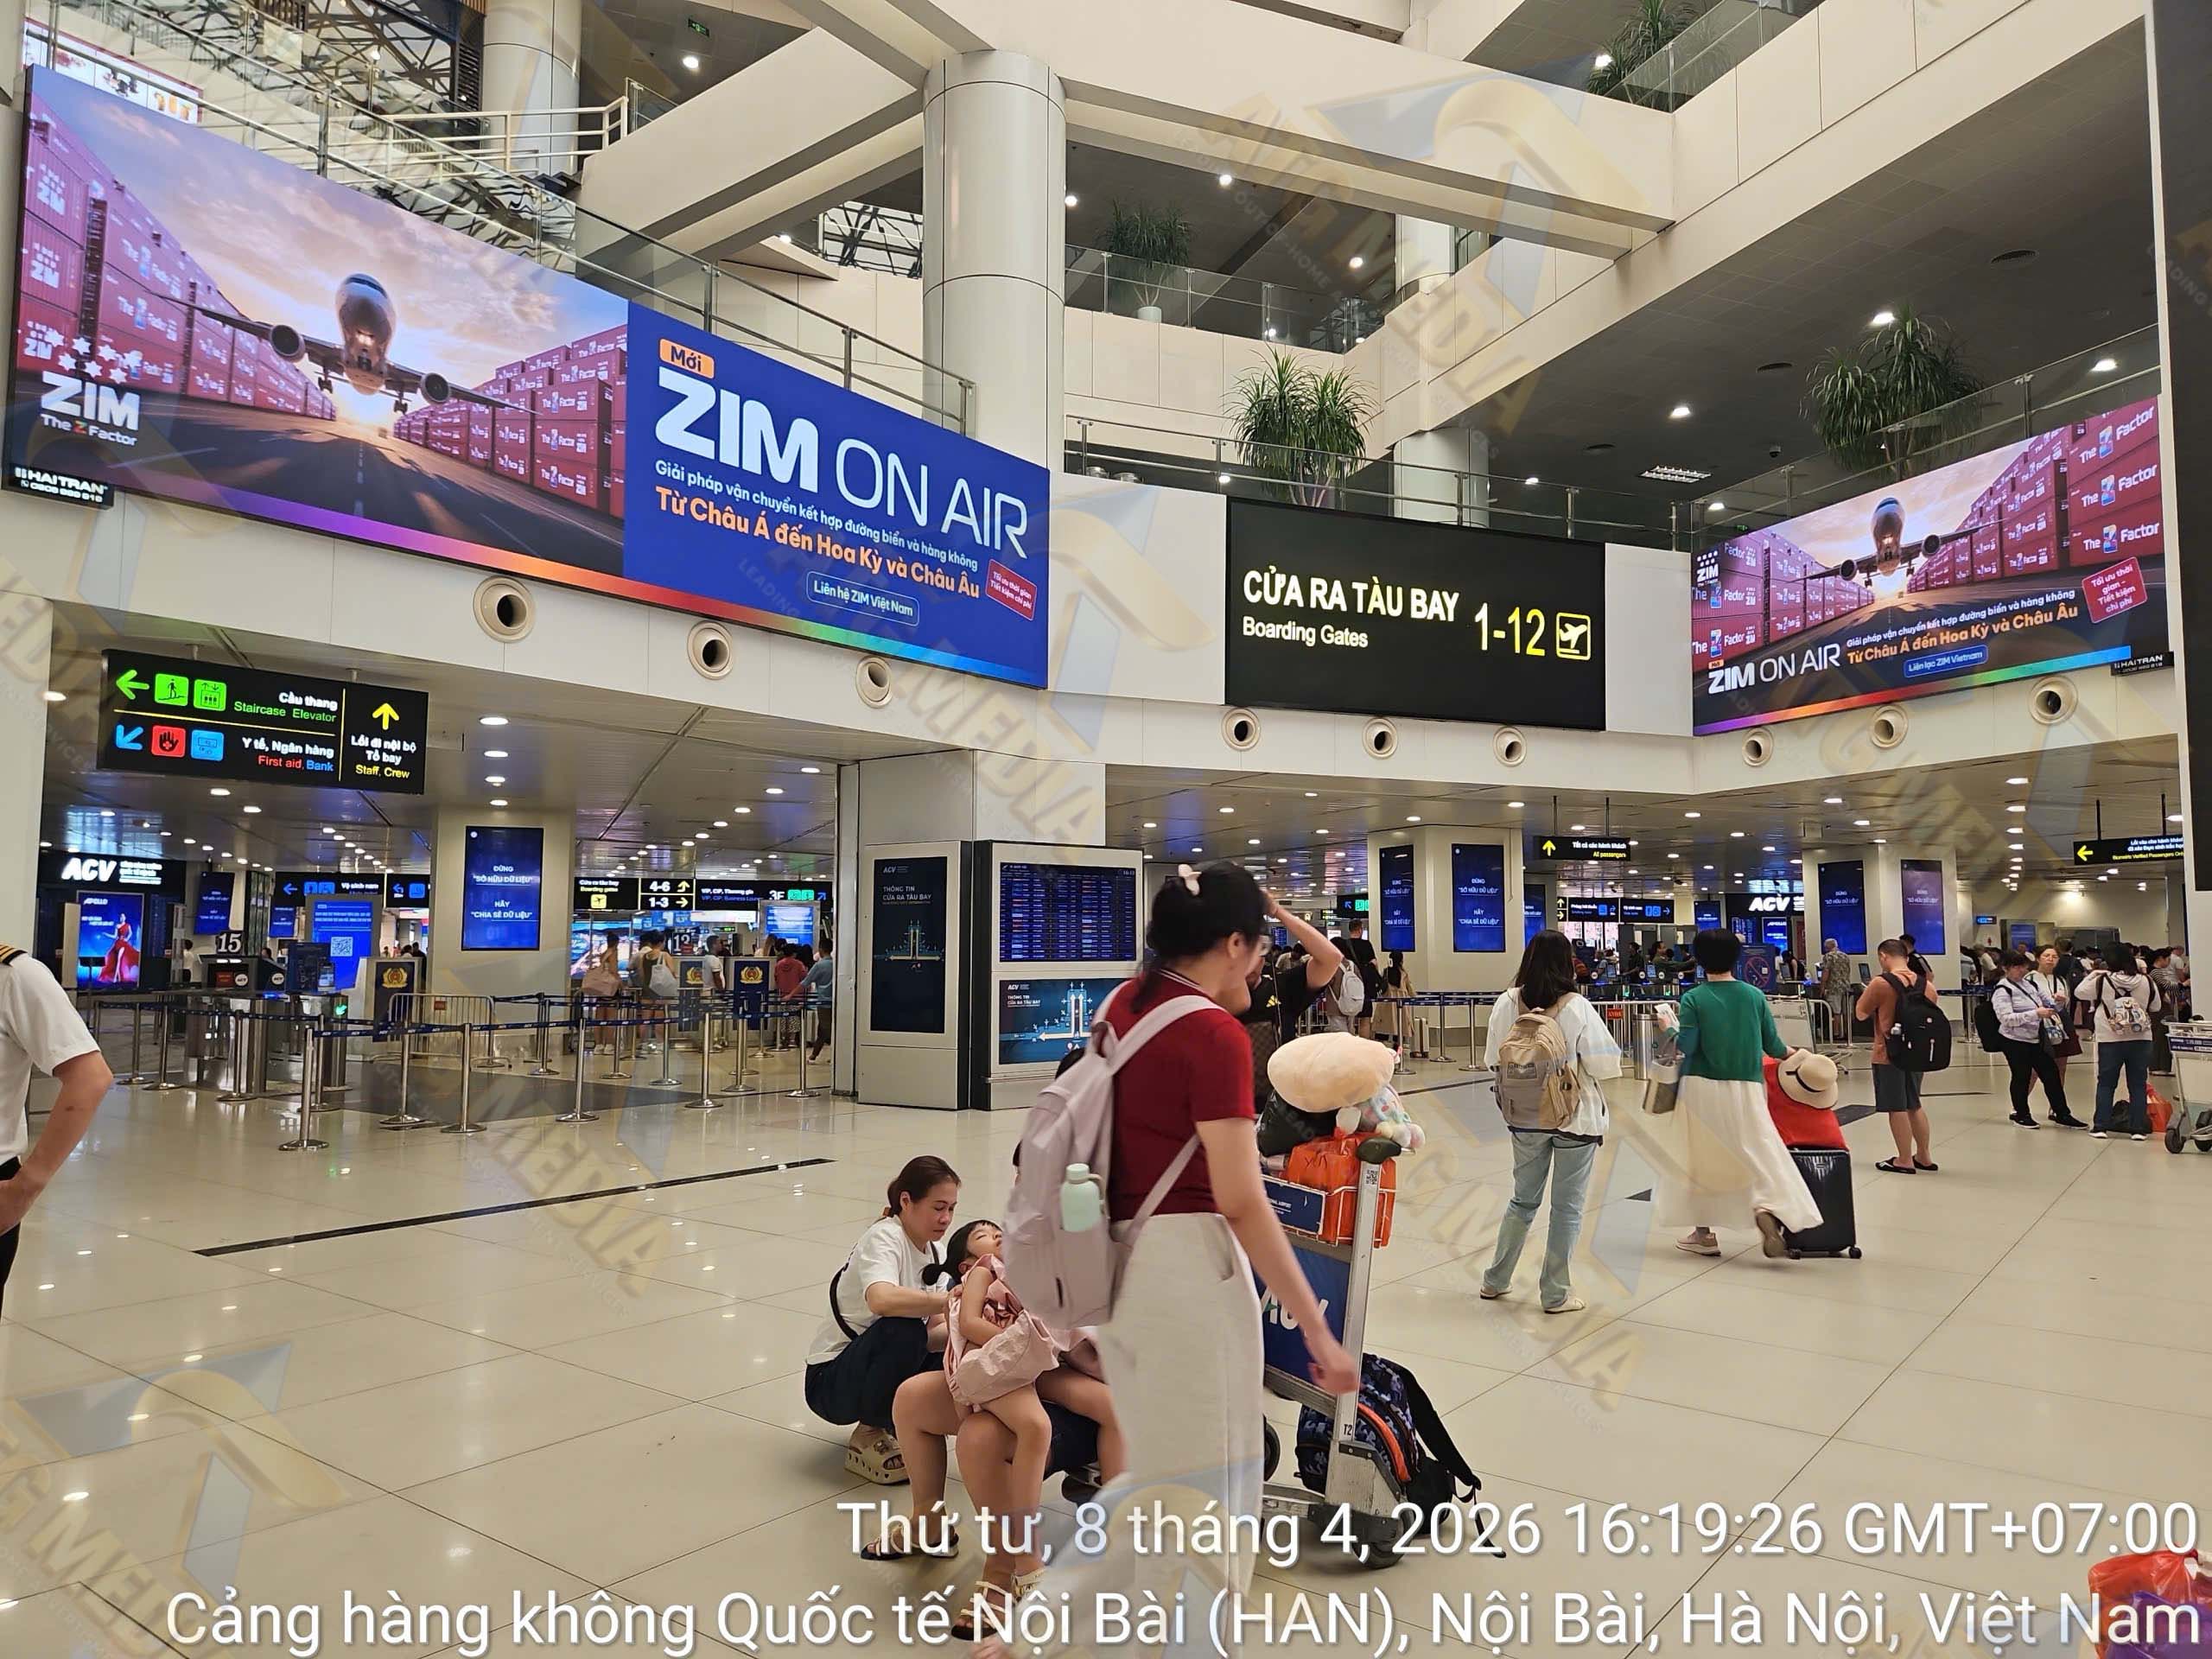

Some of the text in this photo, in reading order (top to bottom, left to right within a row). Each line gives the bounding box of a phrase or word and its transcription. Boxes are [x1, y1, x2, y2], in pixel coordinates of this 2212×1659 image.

[671, 346, 702, 372] Mới
[41, 371, 140, 431] ZIM
[41, 413, 72, 431] The
[88, 425, 138, 446] Factor
[2079, 405, 2155, 464] The Factor
[655, 366, 1027, 559] ZIM ON AIR
[2081, 464, 2158, 508] The Factor
[655, 460, 978, 573] Giải pháp vận chuyển kết hợp đường biển và hàng không
[655, 486, 981, 599] Từ Châu Á đến Hoa Kỳ và Châu Âu
[2082, 522, 2160, 551] The Factor
[1696, 563, 1719, 582] ZIM
[813, 580, 913, 617] Liên hệ ZIM Việt Nam
[1243, 564, 1460, 623] CỬA RA TÀU BAY
[2101, 582, 2120, 595] gian
[1862, 632, 1882, 645] pháp
[1941, 615, 1958, 627] hợp
[1959, 609, 1986, 623] đường
[2007, 600, 2020, 611] và
[2020, 596, 2044, 609] hàng
[2045, 589, 2075, 603] không
[2105, 603, 2119, 613] chi
[1243, 615, 1370, 649] Boarding Gates
[1474, 601, 1547, 657] 1-12
[1847, 601, 2079, 664] Từ Châu Á đến Hoa Kỳ và Châu Âu
[1707, 643, 1840, 695] ZIM ON AIR
[1936, 658, 1951, 667] ZIM
[233, 701, 337, 723] Staircase Elevator
[304, 695, 338, 712] thang
[242, 737, 251, 749] Y
[271, 741, 303, 754] Ngân
[305, 744, 334, 760] hàng
[370, 737, 382, 749] đi
[403, 741, 417, 754] bộ
[257, 755, 283, 766] First
[306, 760, 334, 772] Bank
[382, 753, 402, 766] bay
[355, 765, 410, 779] Staff, Crew
[61, 857, 118, 882] ACV
[649, 880, 671, 892] 4-6
[769, 890, 785, 900] 3F
[649, 897, 669, 908] 1-3
[1748, 896, 1790, 912] ACV
[217, 933, 242, 953] 15
[1343, 1424, 1353, 1436] T2
